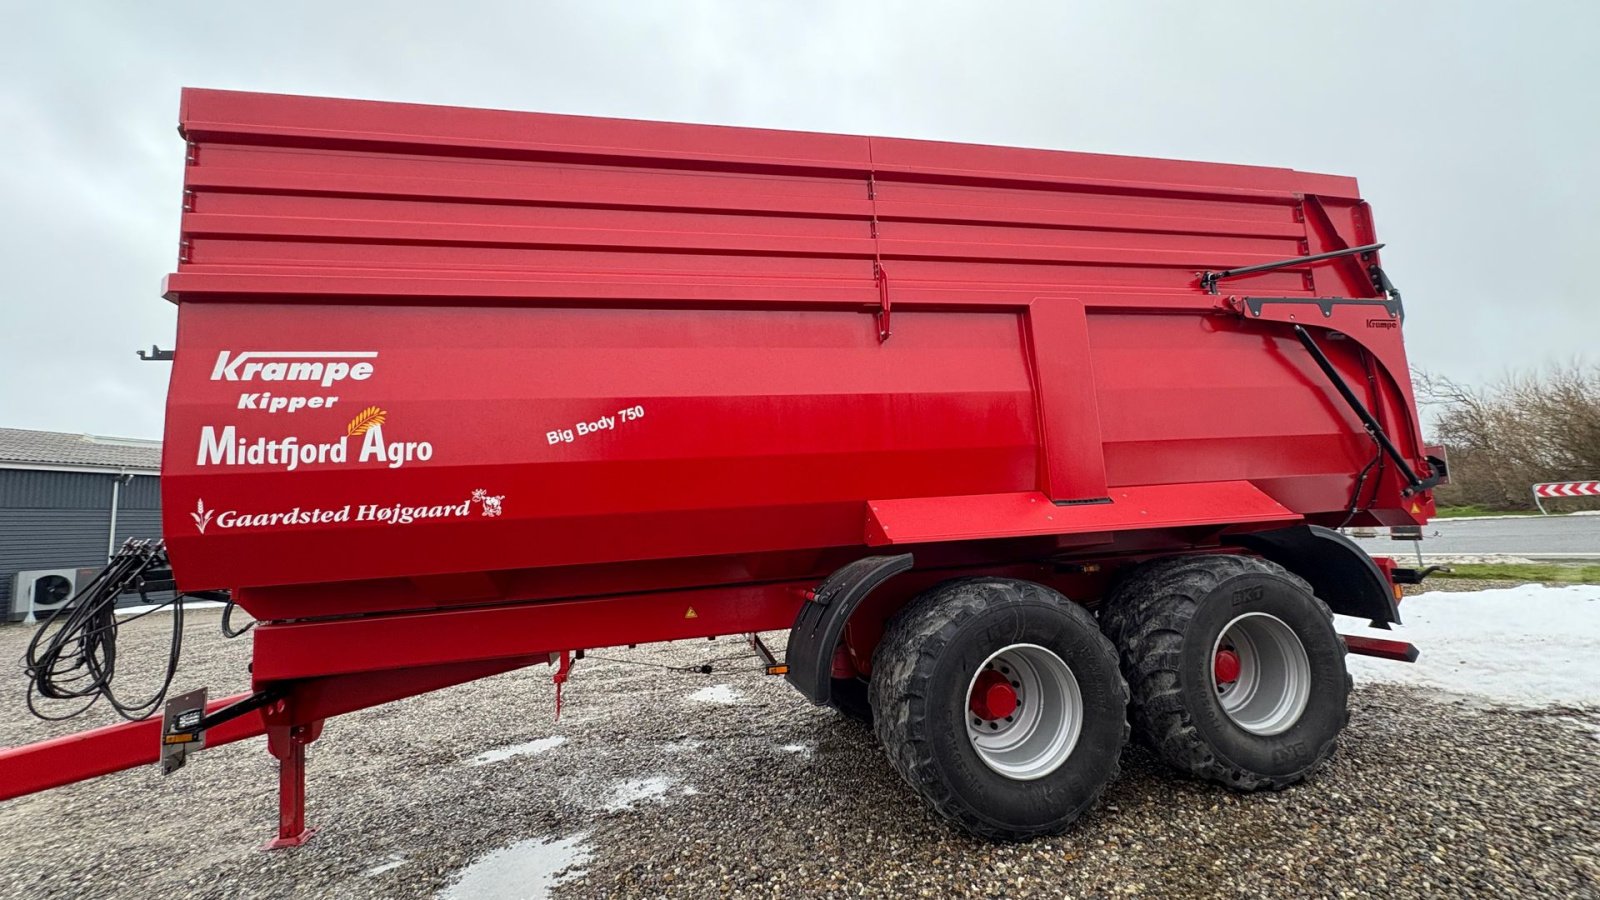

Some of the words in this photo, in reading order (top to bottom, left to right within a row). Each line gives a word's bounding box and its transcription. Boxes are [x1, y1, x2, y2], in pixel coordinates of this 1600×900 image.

[1366, 319, 1397, 330] Krampe
[209, 350, 379, 387] Krampe
[237, 392, 339, 413] Kipper
[545, 429, 575, 445] Big
[575, 415, 615, 436] Body
[617, 405, 645, 423] 750
[196, 425, 349, 471] Midtfjord
[358, 422, 433, 469] Agro
[216, 505, 351, 529] Gaardsted
[355, 499, 471, 525] Højgaard
[1232, 584, 1264, 607] BKT
